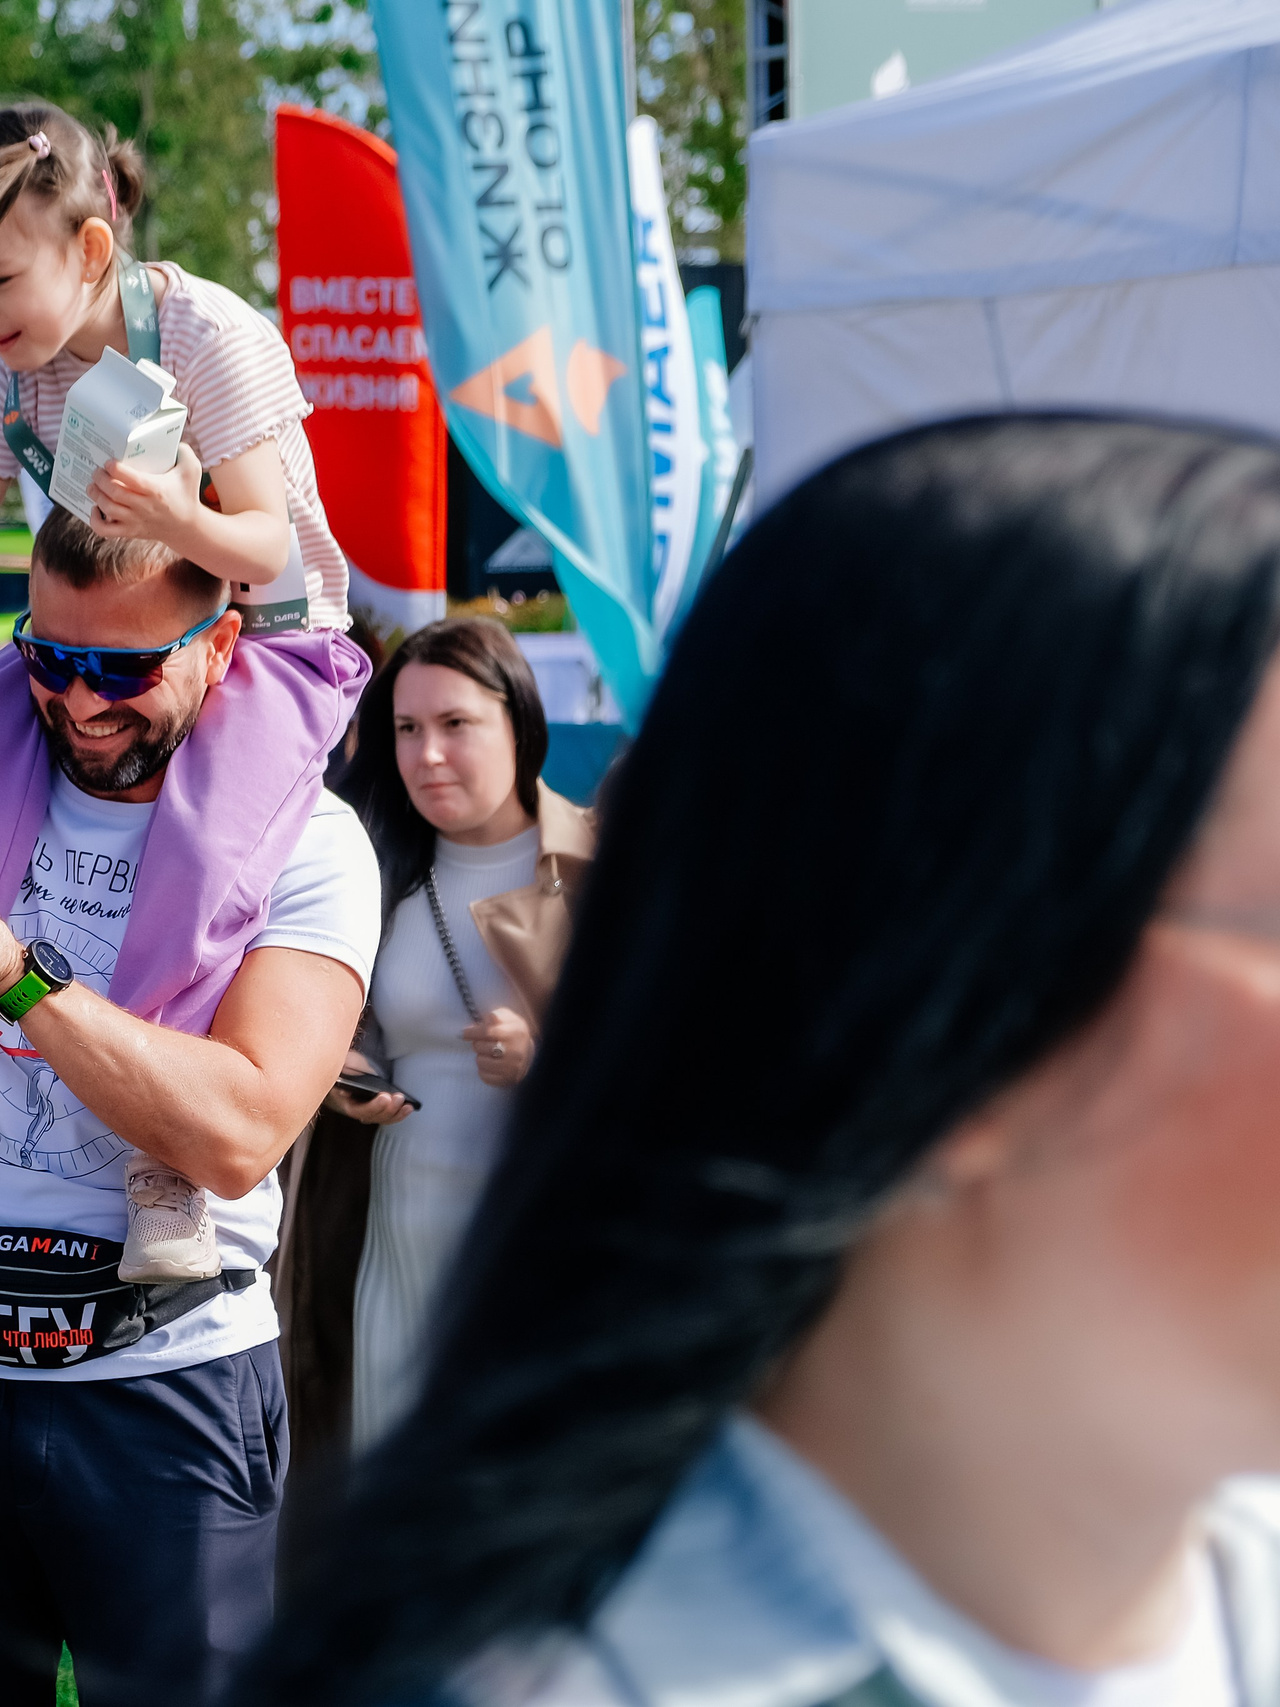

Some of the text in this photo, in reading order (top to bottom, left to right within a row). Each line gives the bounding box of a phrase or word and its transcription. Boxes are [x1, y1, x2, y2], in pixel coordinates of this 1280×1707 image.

[290, 276, 417, 315] ВМЕСТЕ
[3, 1331, 30, 1348] ЧТО
[33, 1329, 93, 1348] ЛЮБЛЮ
